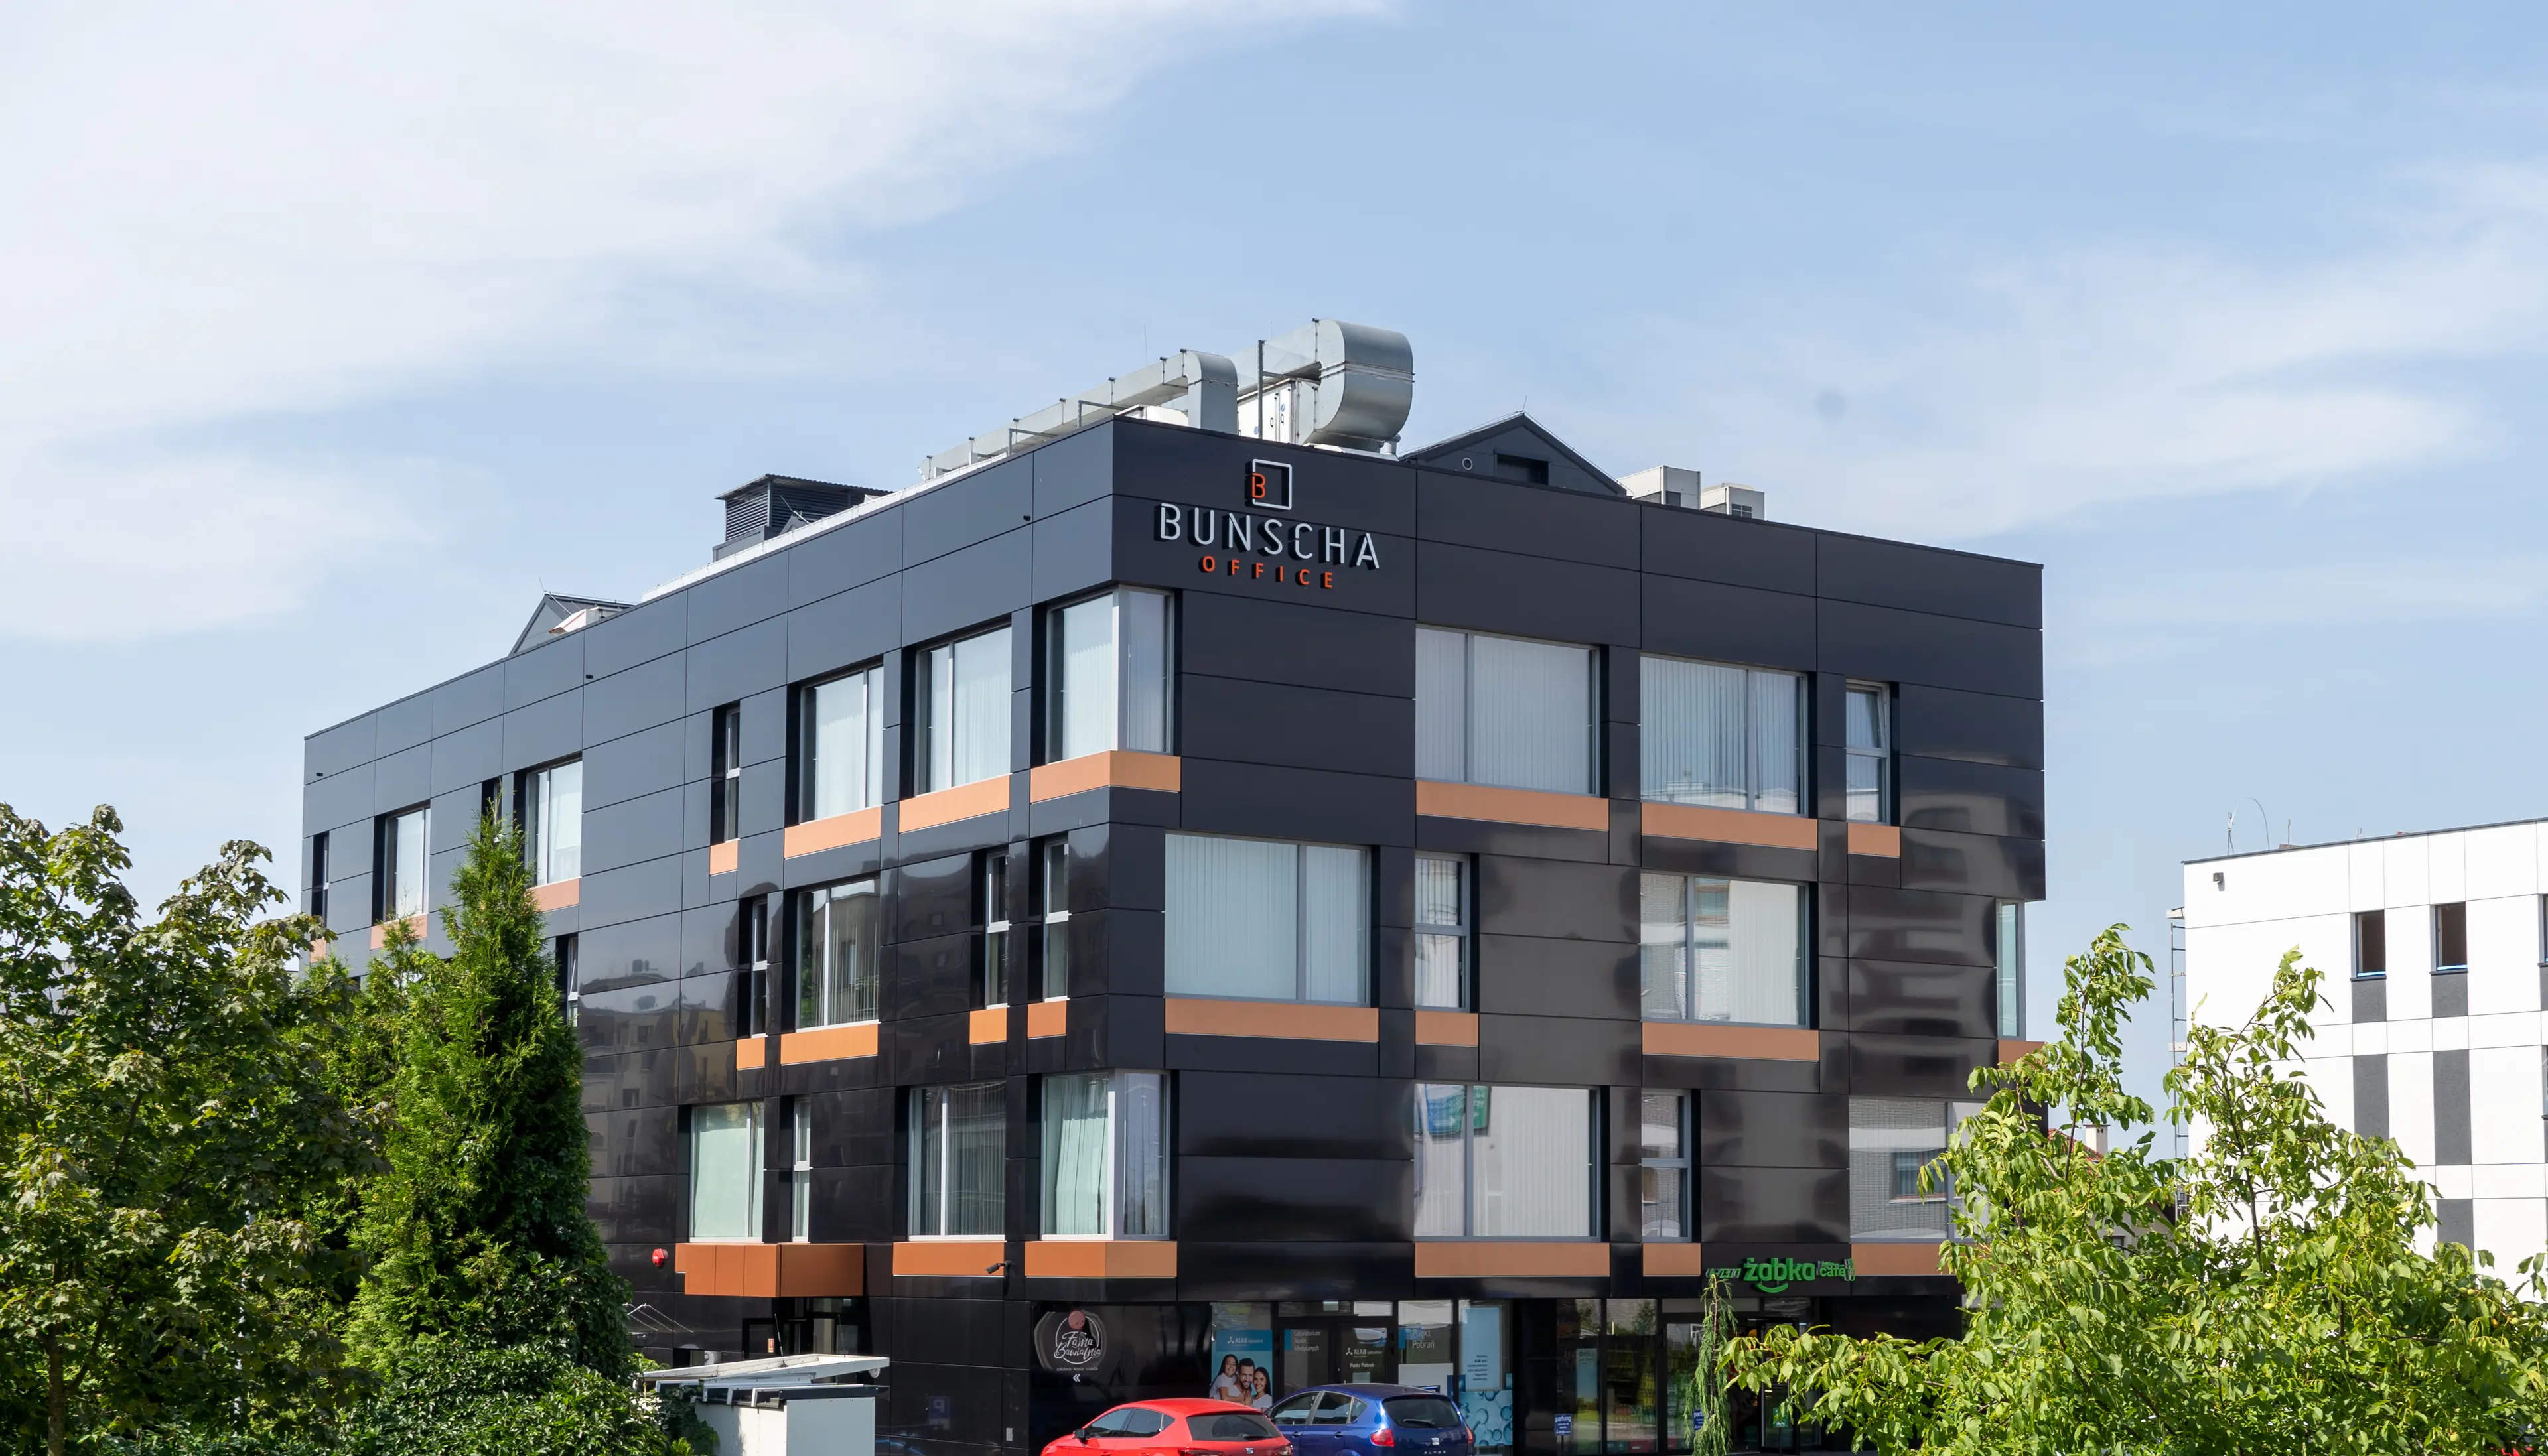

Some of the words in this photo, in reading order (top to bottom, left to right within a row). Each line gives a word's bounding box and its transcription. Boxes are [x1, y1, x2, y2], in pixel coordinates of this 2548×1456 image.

[1251, 473, 1266, 499] B
[1160, 503, 1380, 569] BUNSCHA
[1202, 555, 1334, 589] OFFICE
[1743, 1257, 1816, 1282] żabka
[1062, 1331, 1094, 1349] Fajna
[1412, 1340, 1435, 1349] Pobrań
[1054, 1342, 1101, 1360] Bawialnia
[1555, 1414, 1571, 1422] parking
